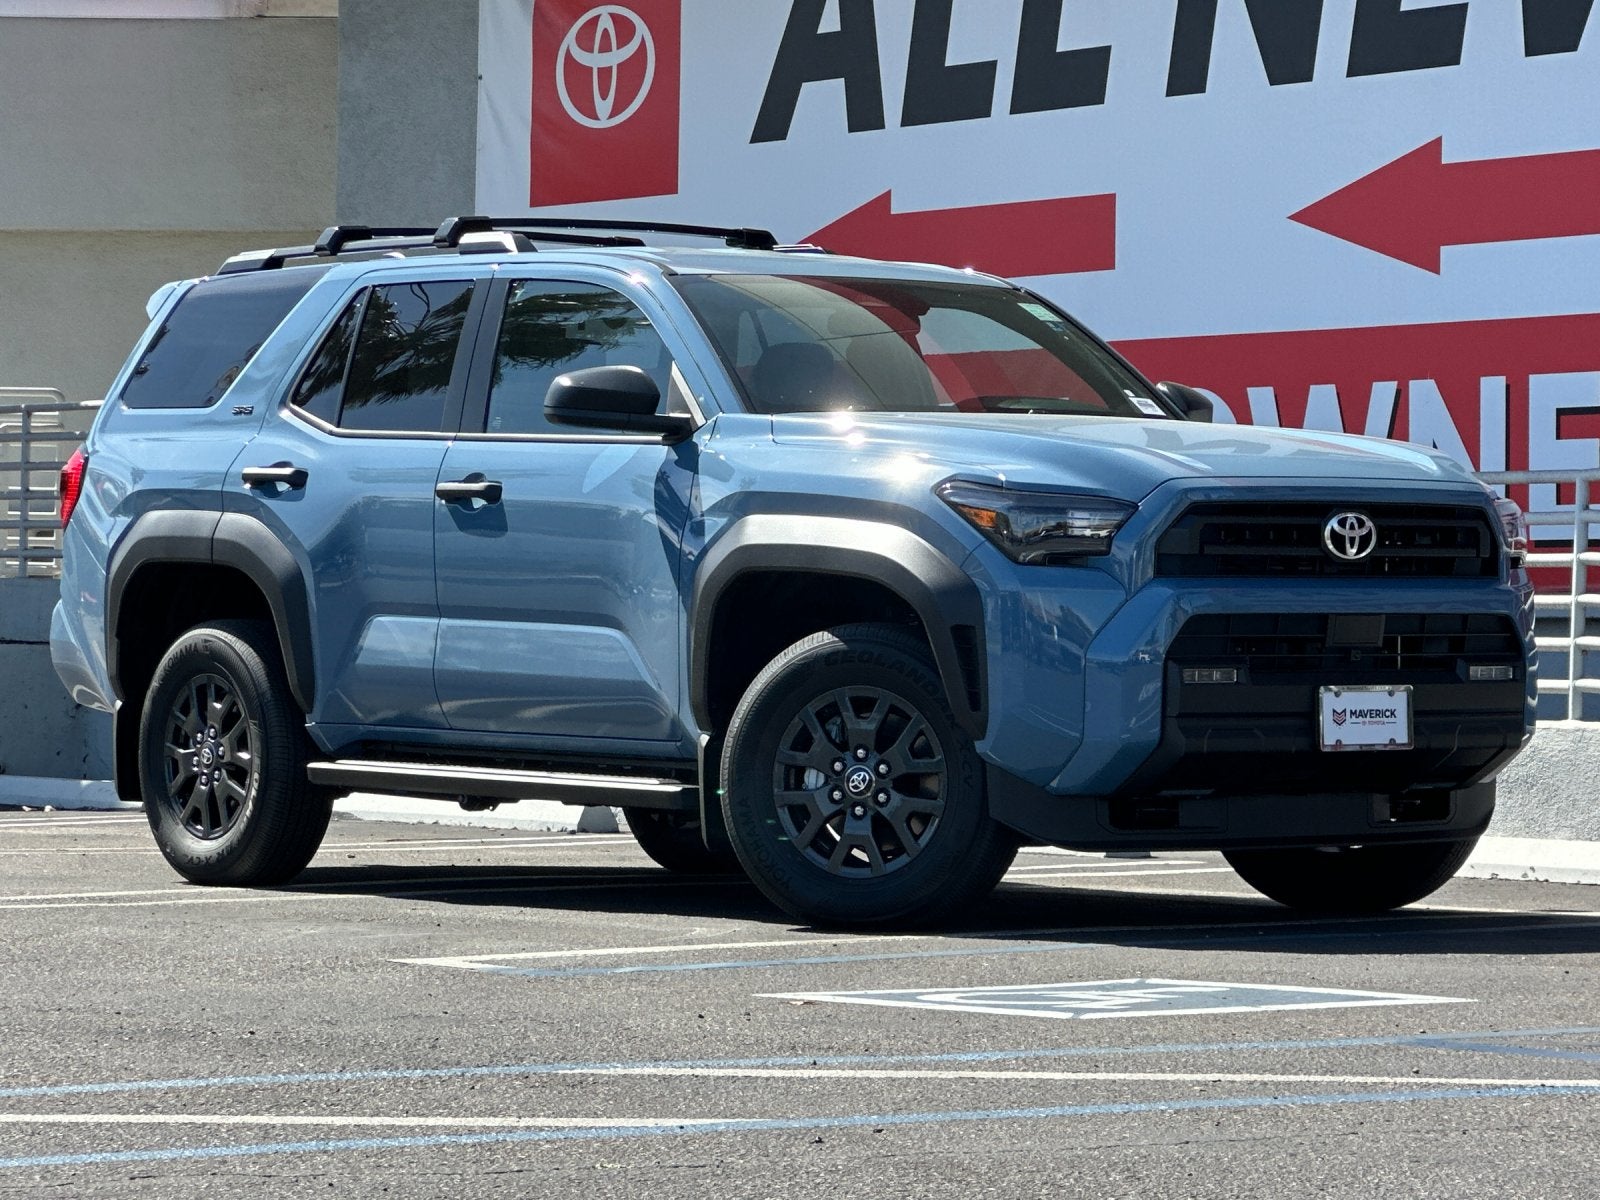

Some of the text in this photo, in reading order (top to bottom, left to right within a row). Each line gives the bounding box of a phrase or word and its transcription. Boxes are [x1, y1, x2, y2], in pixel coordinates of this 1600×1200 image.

[749, 0, 1596, 144] ALL NE
[154, 642, 199, 688] KOHAMA
[1349, 708, 1397, 719] MAVERICK
